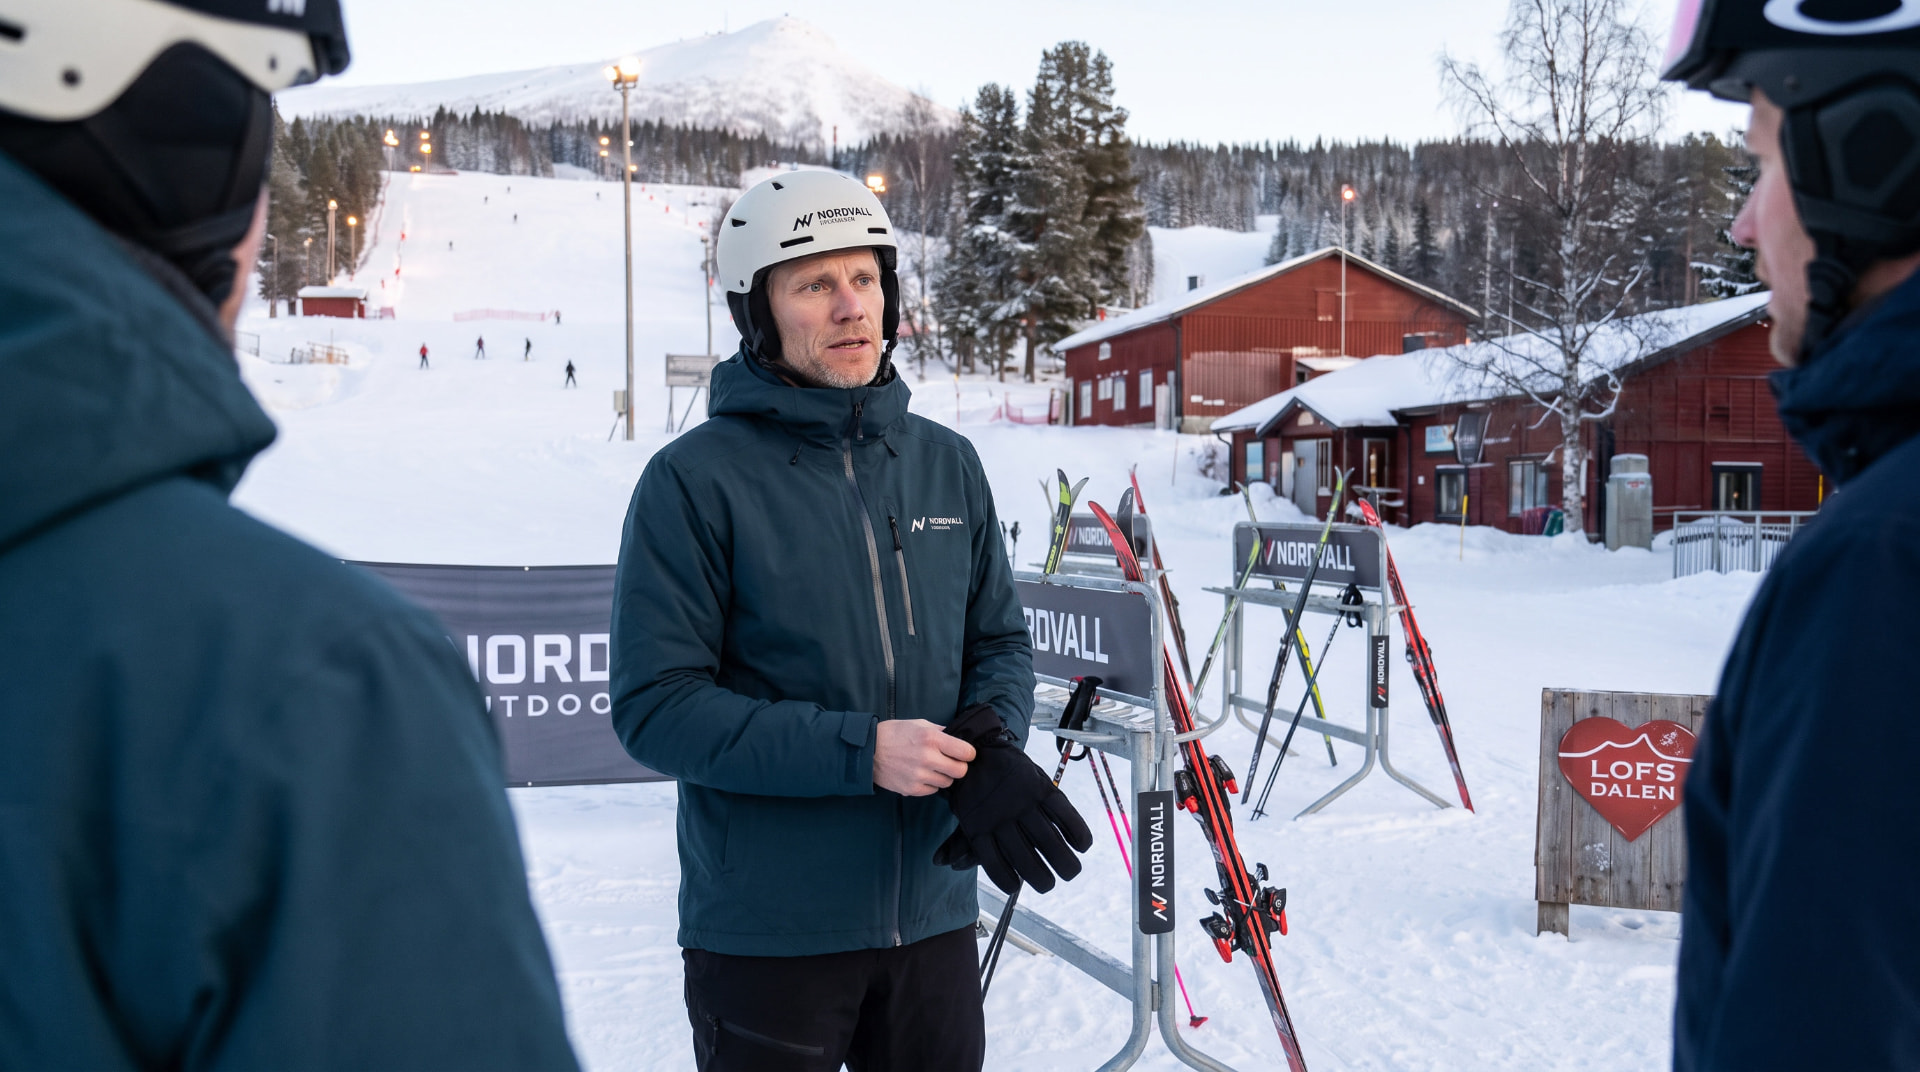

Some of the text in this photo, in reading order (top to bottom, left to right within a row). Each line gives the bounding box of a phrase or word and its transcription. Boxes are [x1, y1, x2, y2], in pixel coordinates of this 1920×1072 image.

[817, 207, 872, 219] NORDVALL
[929, 517, 963, 525] NORDVALL
[1377, 640, 1385, 684] NORDVALL
[1591, 760, 1675, 782] LOFS
[1591, 782, 1675, 800] DALEN
[1150, 802, 1165, 887] NORDVALL
